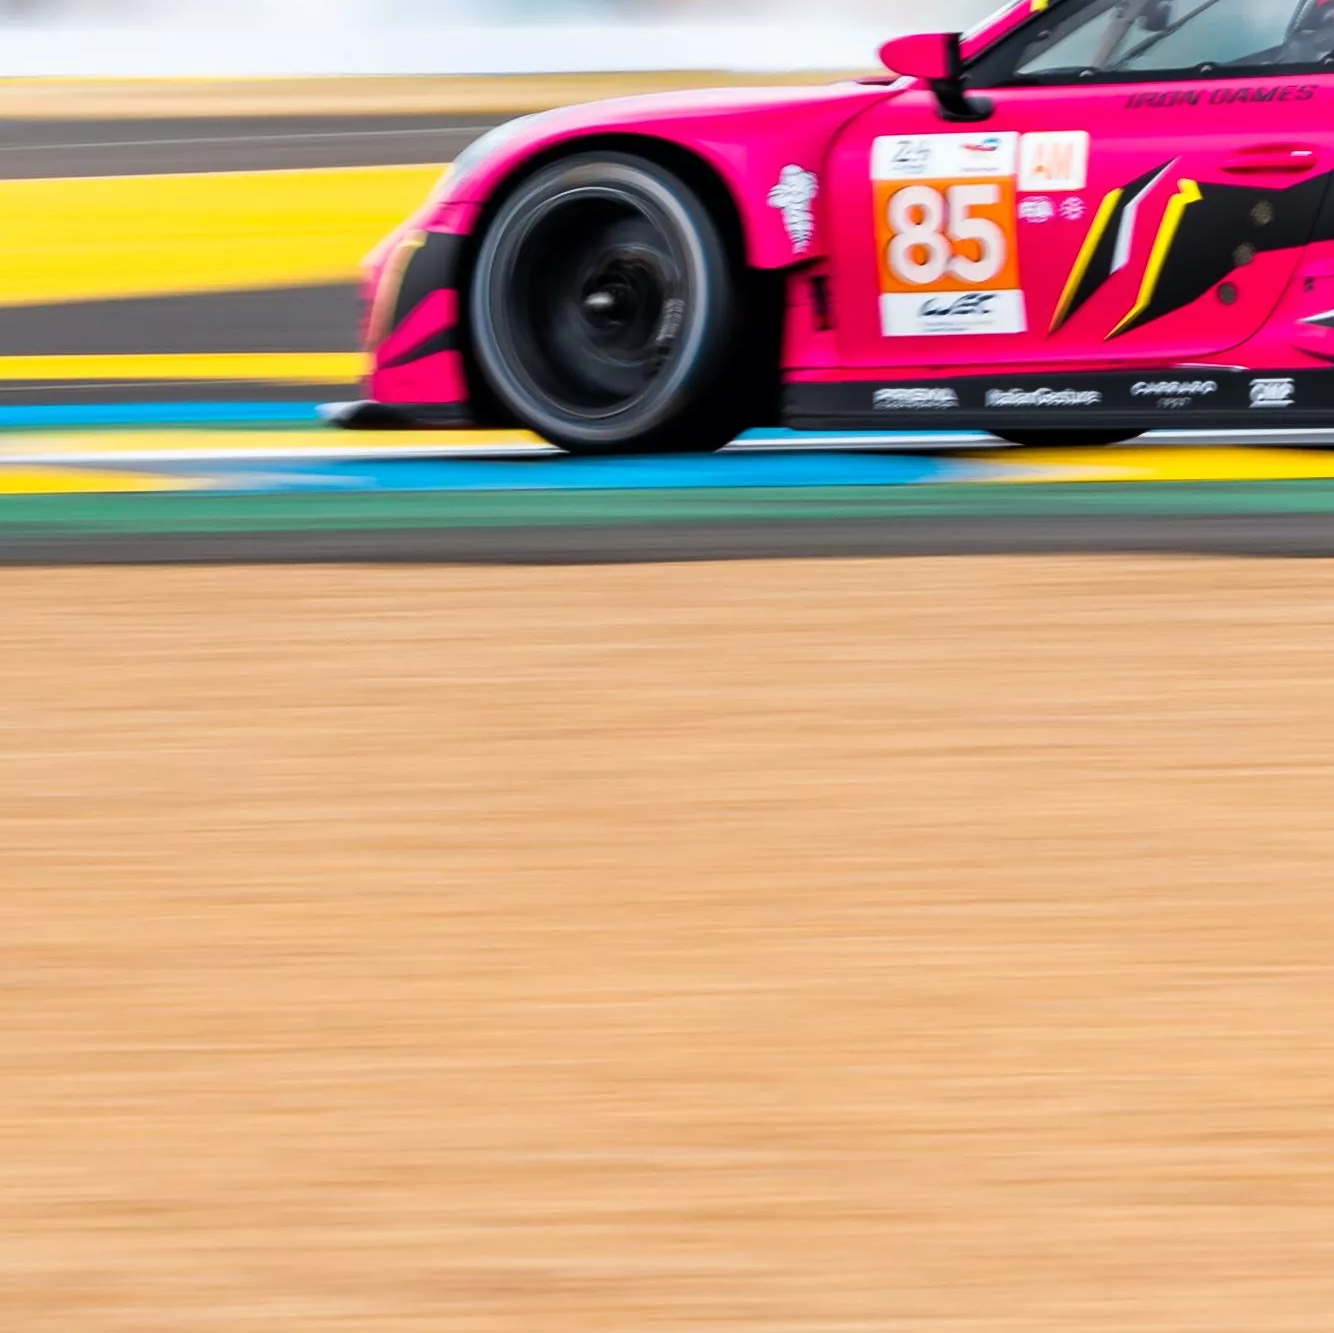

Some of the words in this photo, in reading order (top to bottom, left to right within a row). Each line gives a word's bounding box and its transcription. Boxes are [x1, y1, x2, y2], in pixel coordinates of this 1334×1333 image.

[1124, 88, 1204, 109] IRON
[1207, 83, 1318, 105] DAMES
[1031, 141, 1076, 181] AM
[886, 183, 1007, 286] 85
